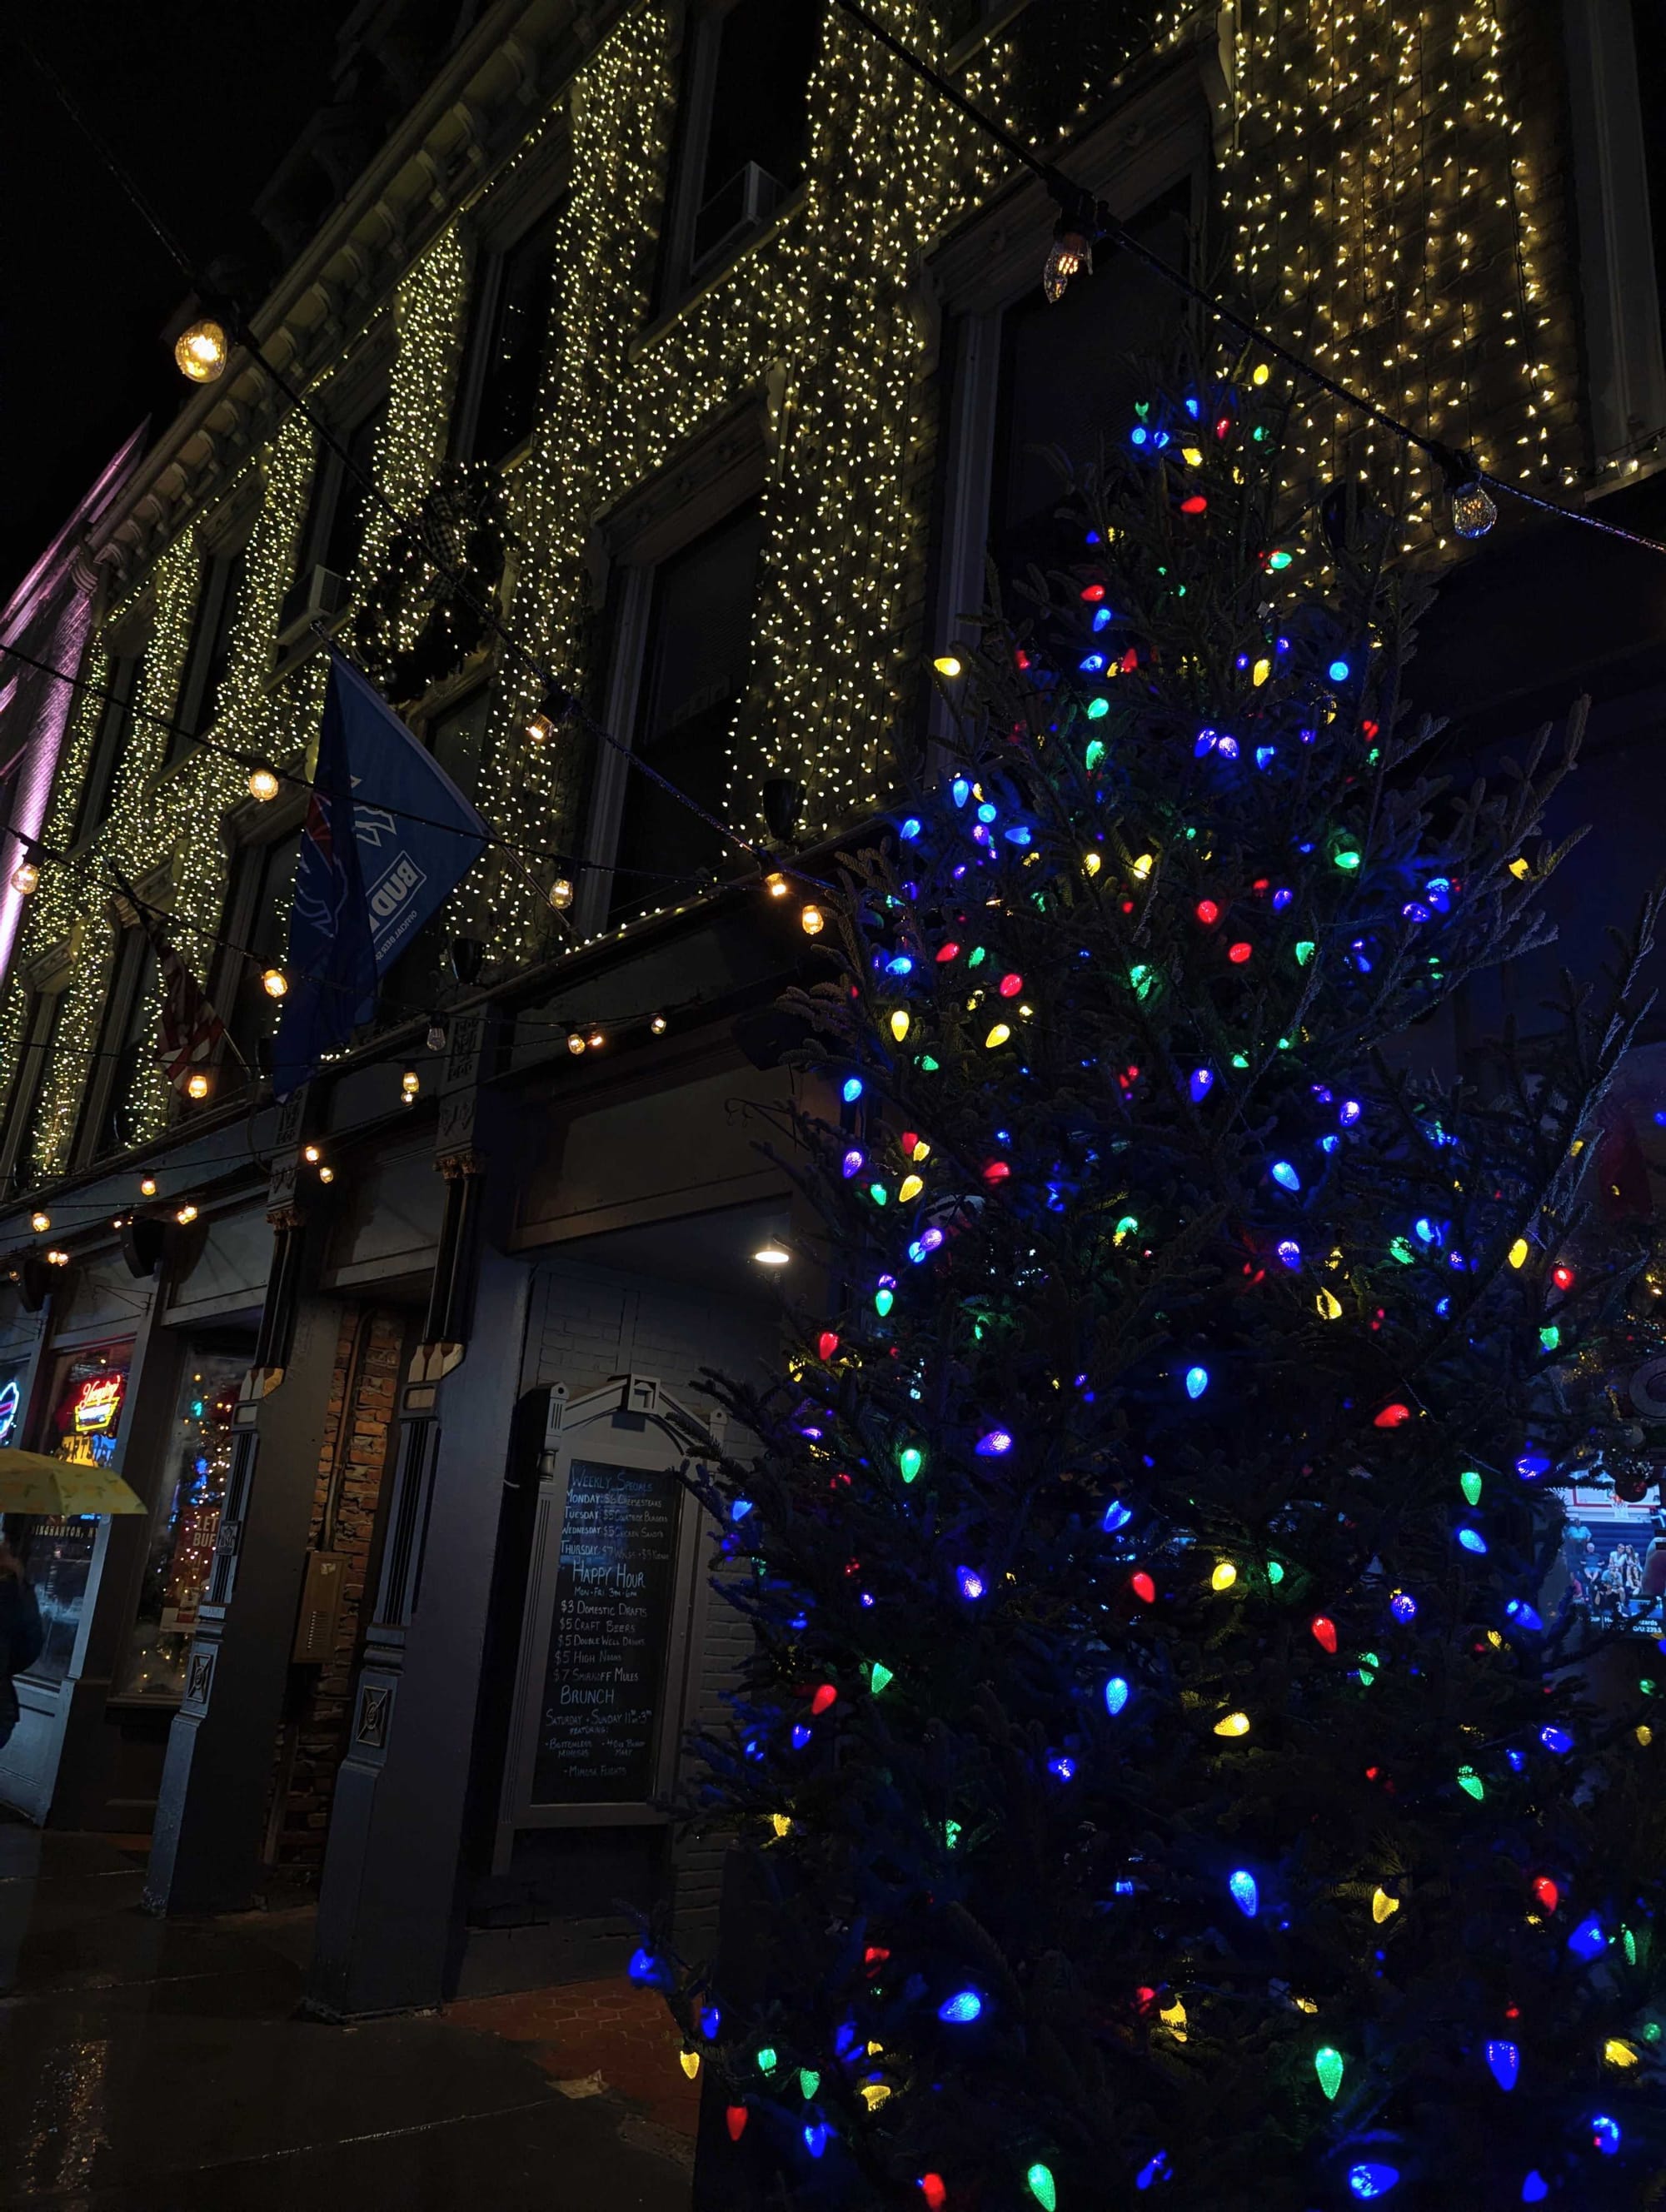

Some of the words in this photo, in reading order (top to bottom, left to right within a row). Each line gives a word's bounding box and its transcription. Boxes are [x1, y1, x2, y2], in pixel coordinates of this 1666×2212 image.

[572, 1467, 612, 1489] WEEKLY
[572, 1559, 612, 1586] HAPPY
[616, 1562, 646, 1588] HOUR
[561, 1599, 575, 1614] $3
[576, 1600, 616, 1617] DOMESTIC
[618, 1602, 647, 1617] DRAFTS
[559, 1617, 573, 1631] $5
[574, 1617, 600, 1630] CRAFT
[606, 1620, 636, 1632] BEERS
[557, 1633, 572, 1647] $5
[573, 1633, 600, 1647] DOUBLE
[554, 1650, 571, 1665] $5
[573, 1650, 595, 1664] HIGH
[552, 1667, 571, 1682] $7
[614, 1666, 639, 1682] MULES
[560, 1685, 615, 1706] BRUNCH
